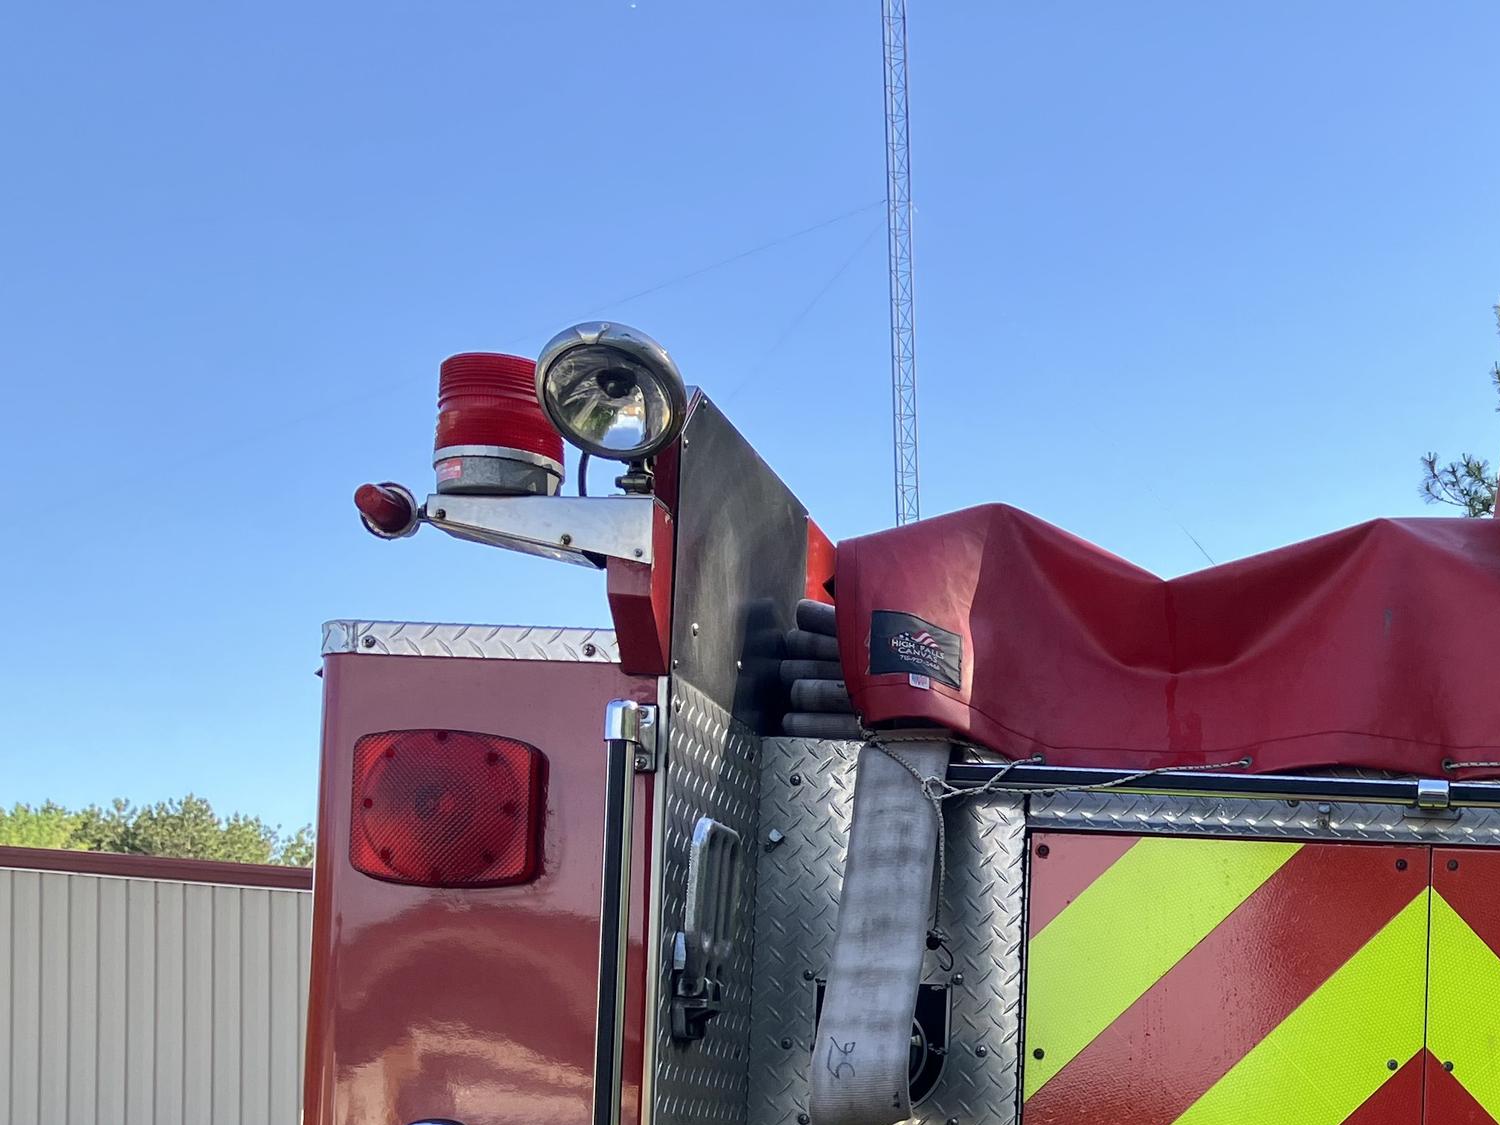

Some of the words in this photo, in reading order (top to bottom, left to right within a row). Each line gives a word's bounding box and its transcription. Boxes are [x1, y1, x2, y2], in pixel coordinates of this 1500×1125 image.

[891, 638, 915, 649] HIGH
[920, 645, 945, 660] FALLS
[897, 647, 938, 663] CANVAS
